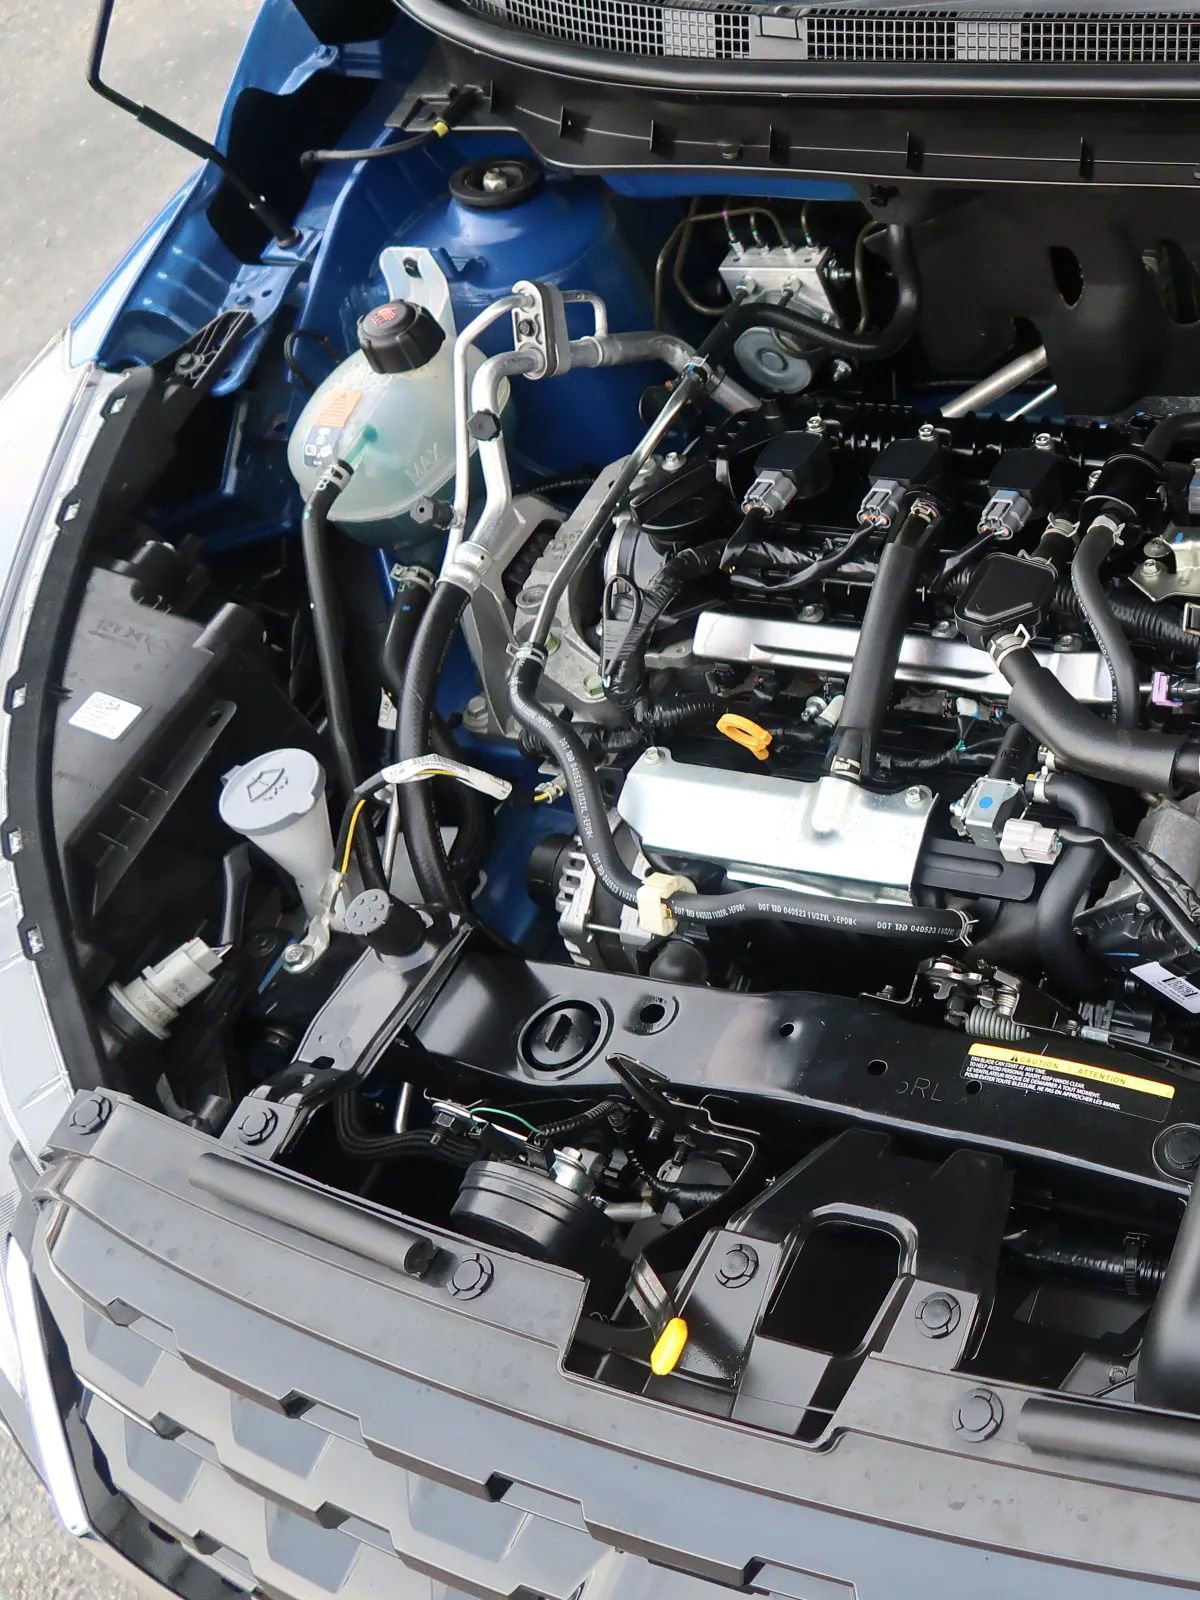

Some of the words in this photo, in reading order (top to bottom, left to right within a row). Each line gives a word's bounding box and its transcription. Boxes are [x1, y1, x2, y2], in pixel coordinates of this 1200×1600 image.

[404, 442, 445, 483] MAX
[569, 762, 584, 789] 040523
[757, 902, 770, 911] DOT
[783, 906, 806, 918] 040523
[876, 921, 893, 930] DOT
[910, 925, 936, 934] 040523
[973, 1067, 1004, 1078] VENTILATEUR
[1004, 1073, 1022, 1081] RISQUE
[1002, 1068, 1024, 1076] PERSONAL
[1053, 1077, 1070, 1085] HANDS
[1019, 1056, 1059, 1069] CAUTION
[1077, 1068, 1126, 1085] ATTENTION
[1062, 1090, 1093, 1103] APPROCHER
